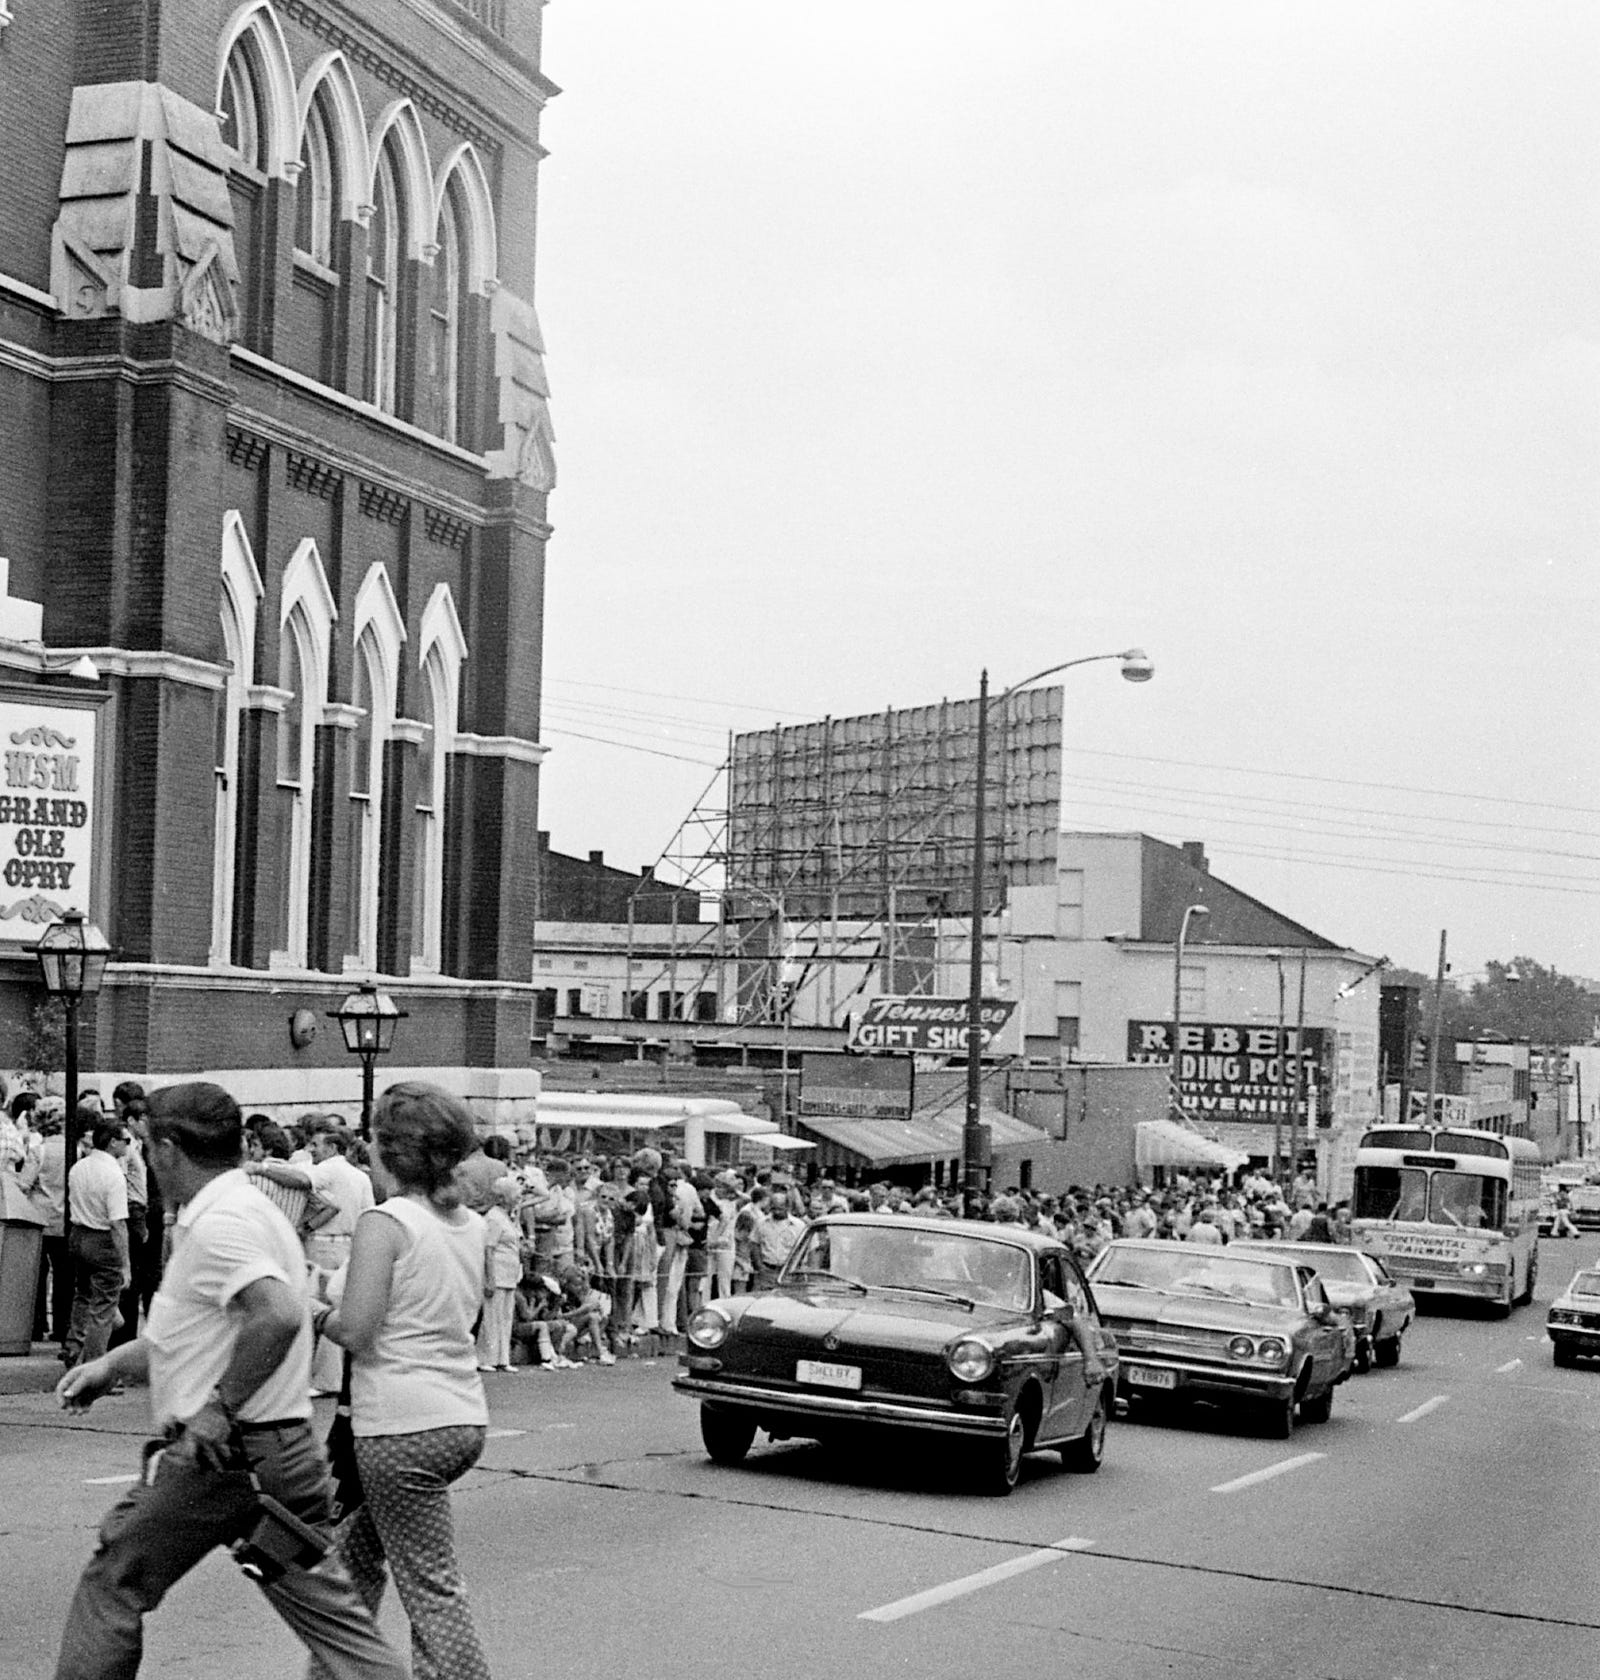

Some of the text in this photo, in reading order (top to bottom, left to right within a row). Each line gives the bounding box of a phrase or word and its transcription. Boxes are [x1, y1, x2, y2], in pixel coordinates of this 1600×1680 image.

[4, 750, 80, 792] WSM
[14, 828, 65, 858] OLE
[3, 858, 76, 890] OPRY
[872, 1000, 1007, 1023] Tennesee
[858, 1024, 918, 1048] GIFT
[1138, 1024, 1314, 1057] REBEL
[1249, 1058, 1319, 1085] POST
[1383, 1234, 1466, 1250] CONTINENTAL
[1387, 1243, 1460, 1258] TRAILWAYS
